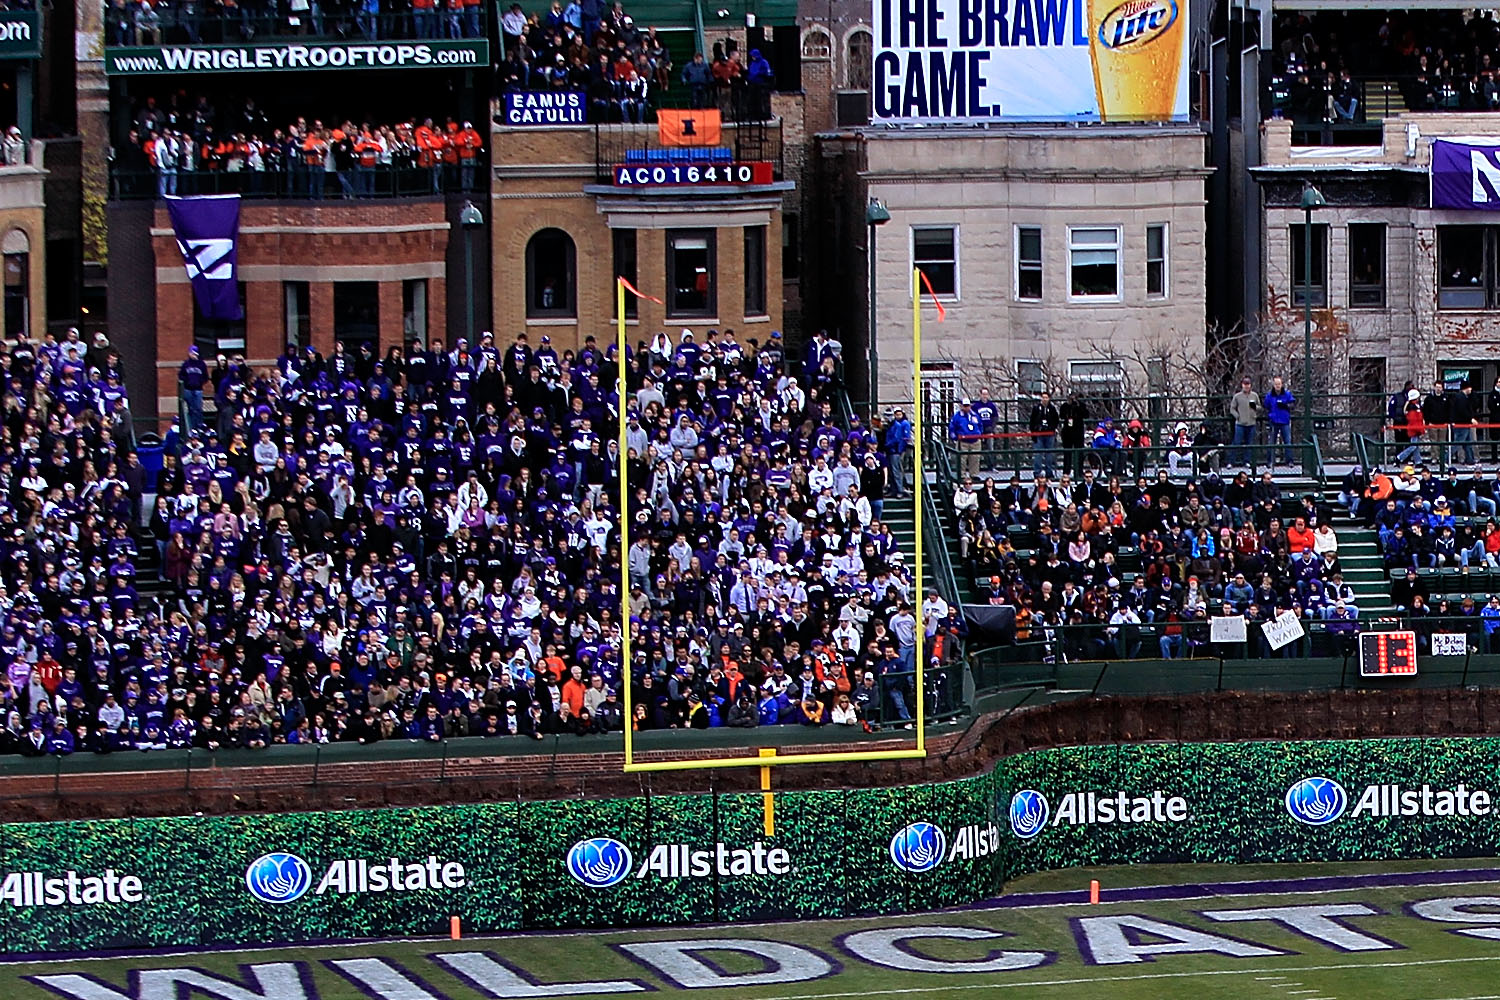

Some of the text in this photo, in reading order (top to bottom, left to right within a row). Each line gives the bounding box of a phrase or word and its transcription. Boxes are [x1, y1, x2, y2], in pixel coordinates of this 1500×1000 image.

[880, 0, 948, 48] THE
[1112, 8, 1167, 48] Lite
[513, 94, 579, 108] EAMUS
[874, 51, 1001, 117] GAME.
[681, 119, 697, 136] I
[1378, 634, 1416, 674] 13
[1053, 790, 1187, 827] Allstate
[1351, 783, 1491, 818] Allstate
[315, 855, 466, 895] Allstate
[637, 842, 791, 879] Allstate
[0, 869, 143, 907] Allstate
